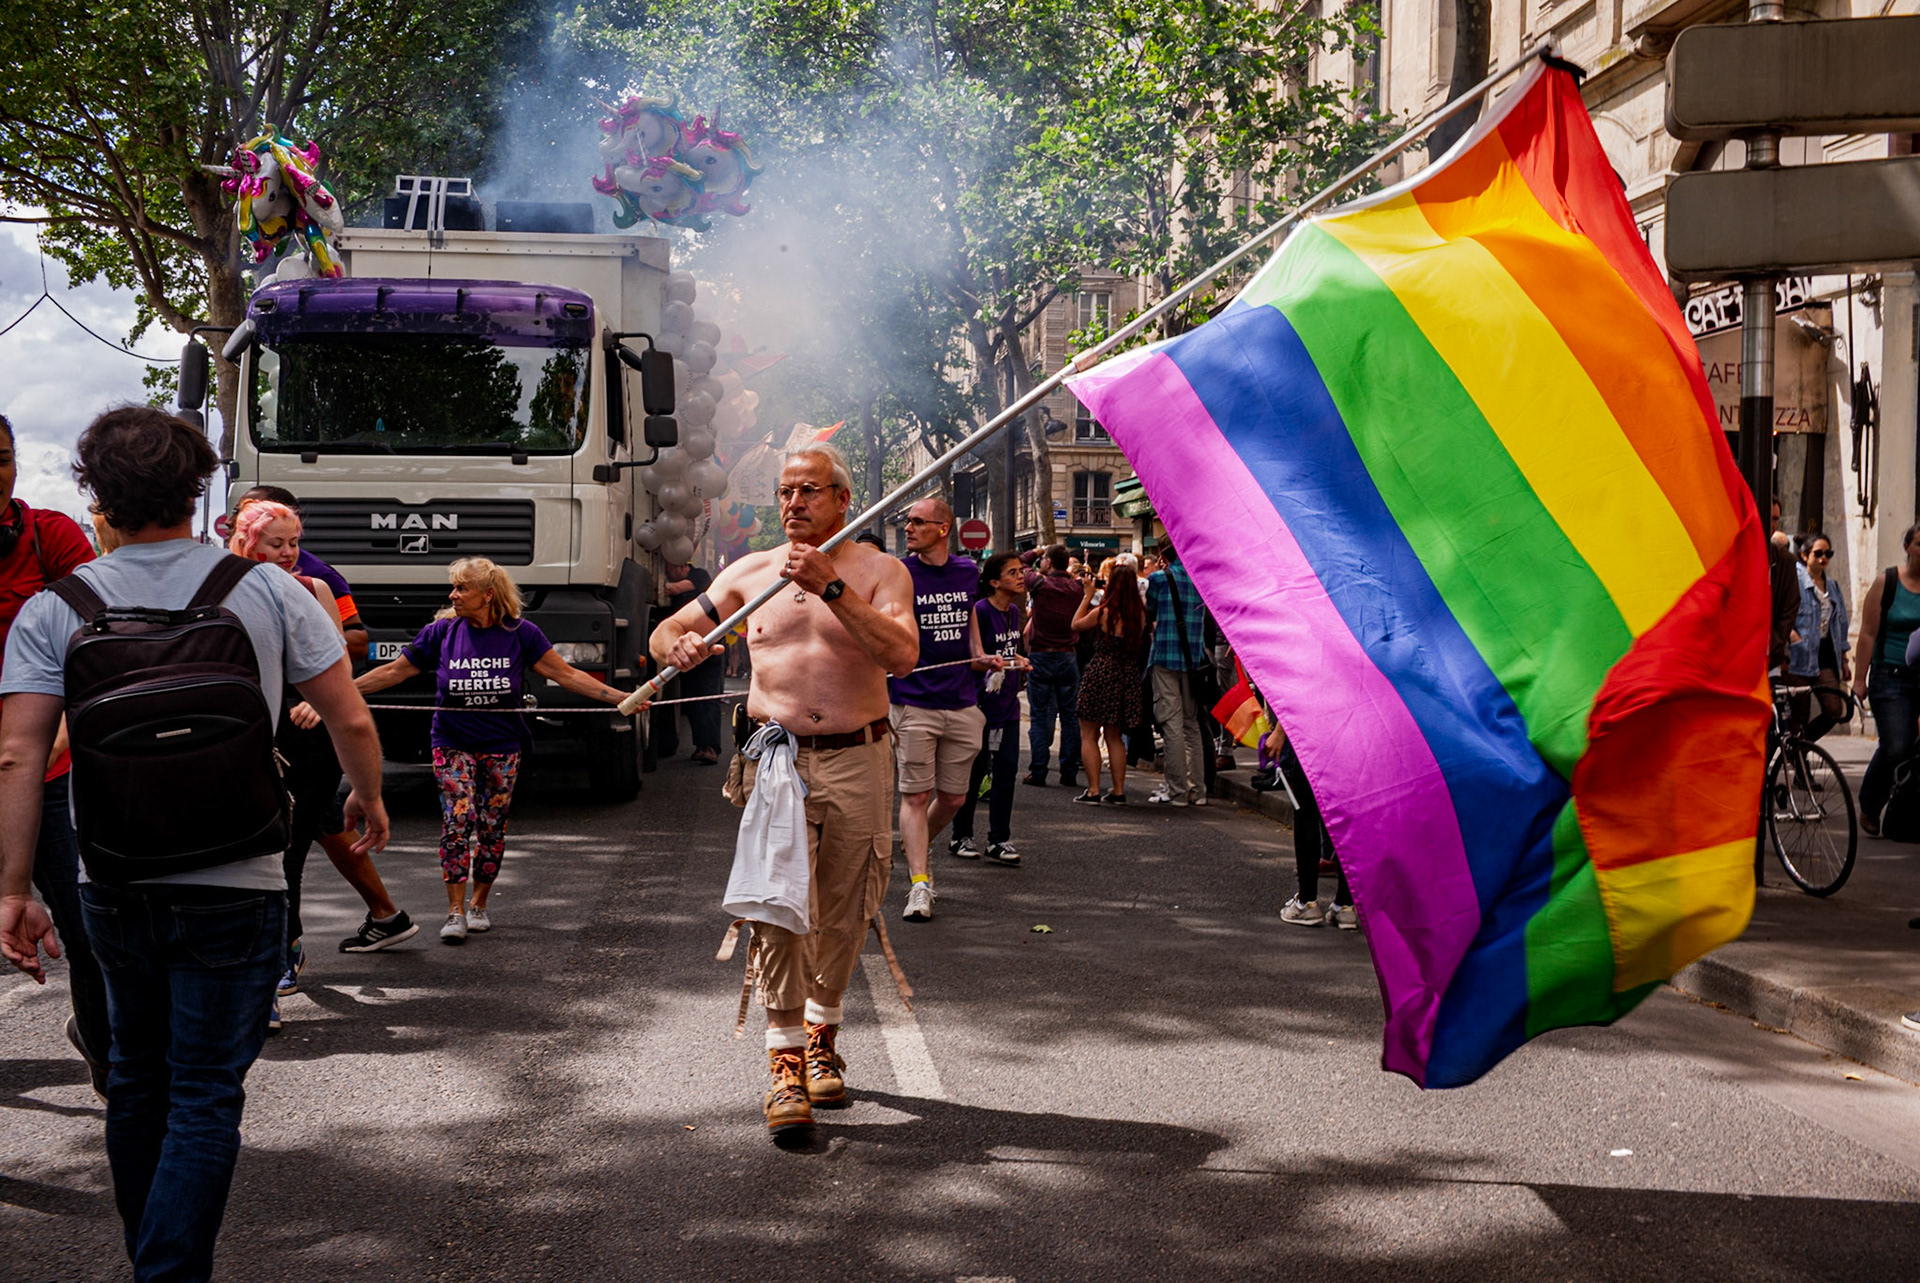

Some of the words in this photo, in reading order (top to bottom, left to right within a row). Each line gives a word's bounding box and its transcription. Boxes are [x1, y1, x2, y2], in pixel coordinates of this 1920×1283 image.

[1702, 362, 1742, 384] AF
[371, 513, 458, 530] MAN
[916, 592, 968, 605] MARCHE
[937, 603, 953, 612] DES
[920, 609, 968, 624] FIERTÉS
[934, 629, 961, 641] 2016
[448, 657, 511, 670] MARCHE
[470, 670, 489, 678] DES
[448, 675, 511, 691] FIERTÉS
[464, 695, 499, 706] 2016
